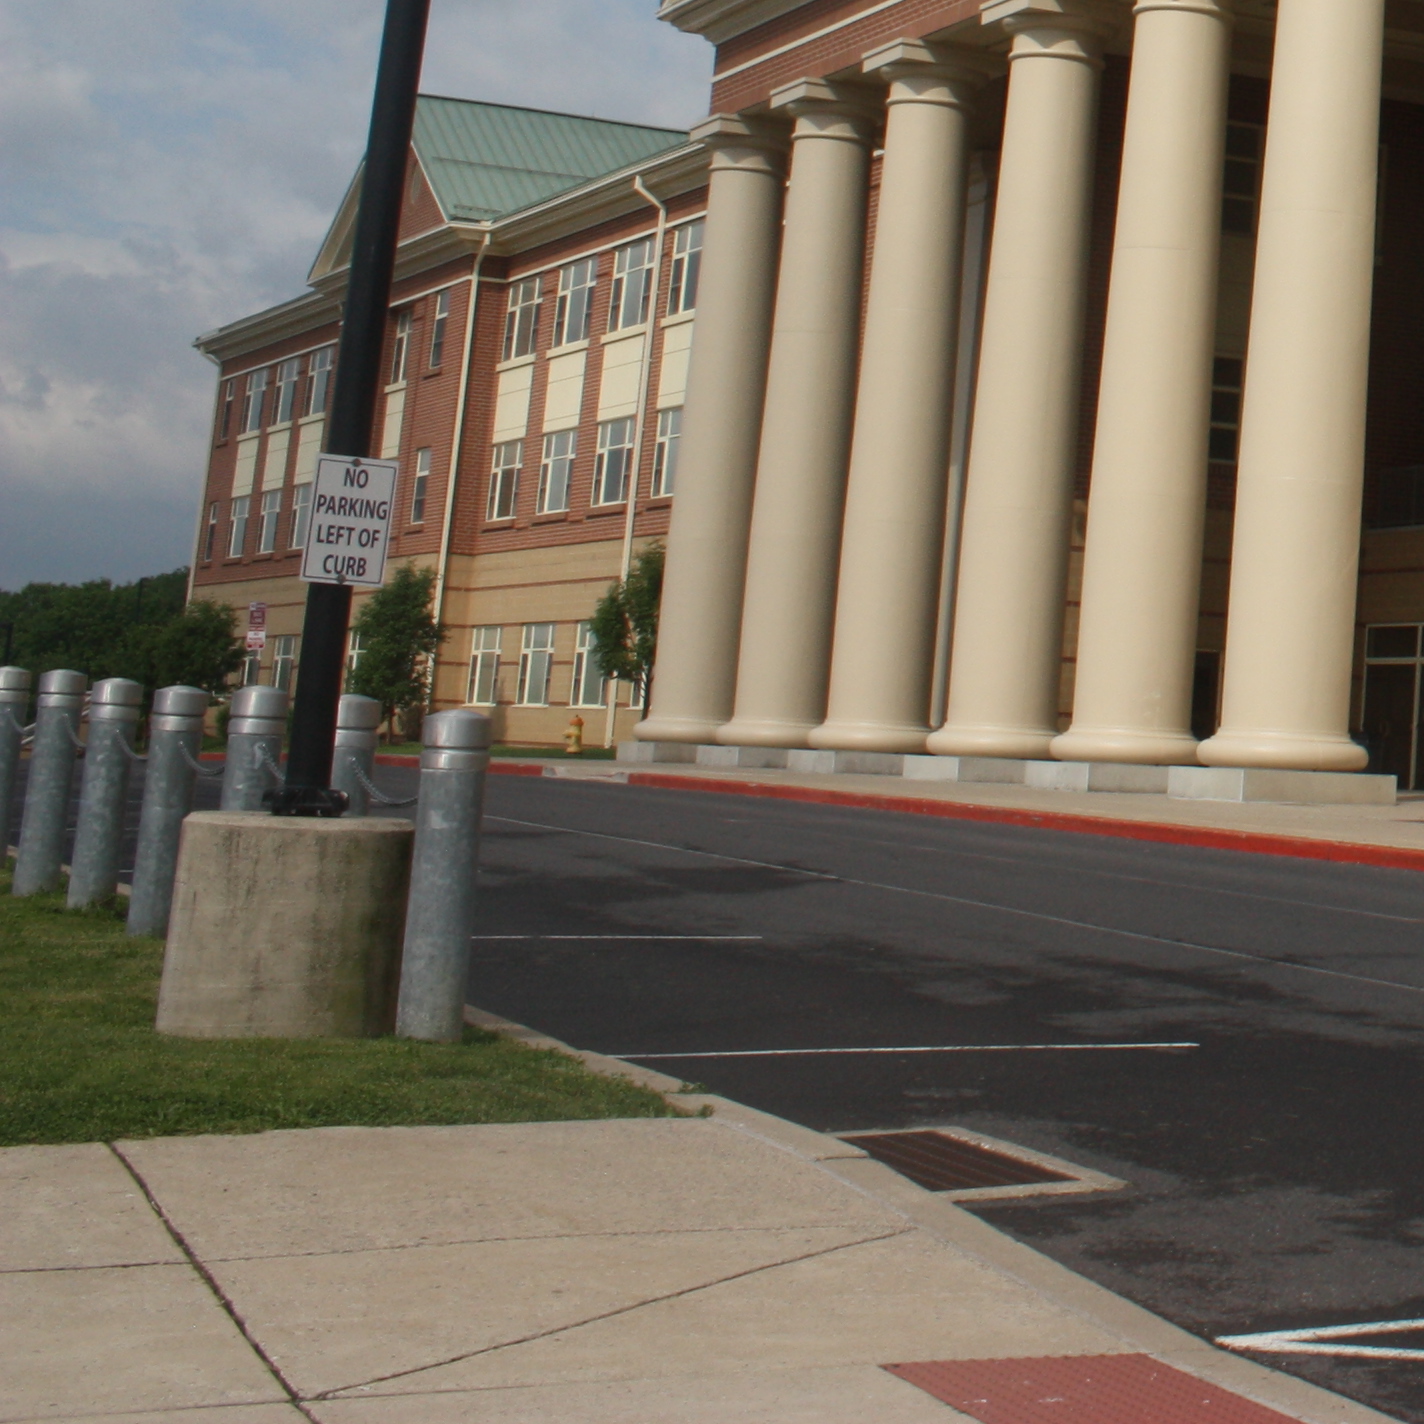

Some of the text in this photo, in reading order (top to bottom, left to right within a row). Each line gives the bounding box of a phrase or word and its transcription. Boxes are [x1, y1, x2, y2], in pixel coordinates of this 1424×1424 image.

[344, 468, 368, 488] NO
[316, 494, 388, 520] PARKING
[316, 524, 381, 548] LEFT OF
[323, 554, 367, 577] CURB
